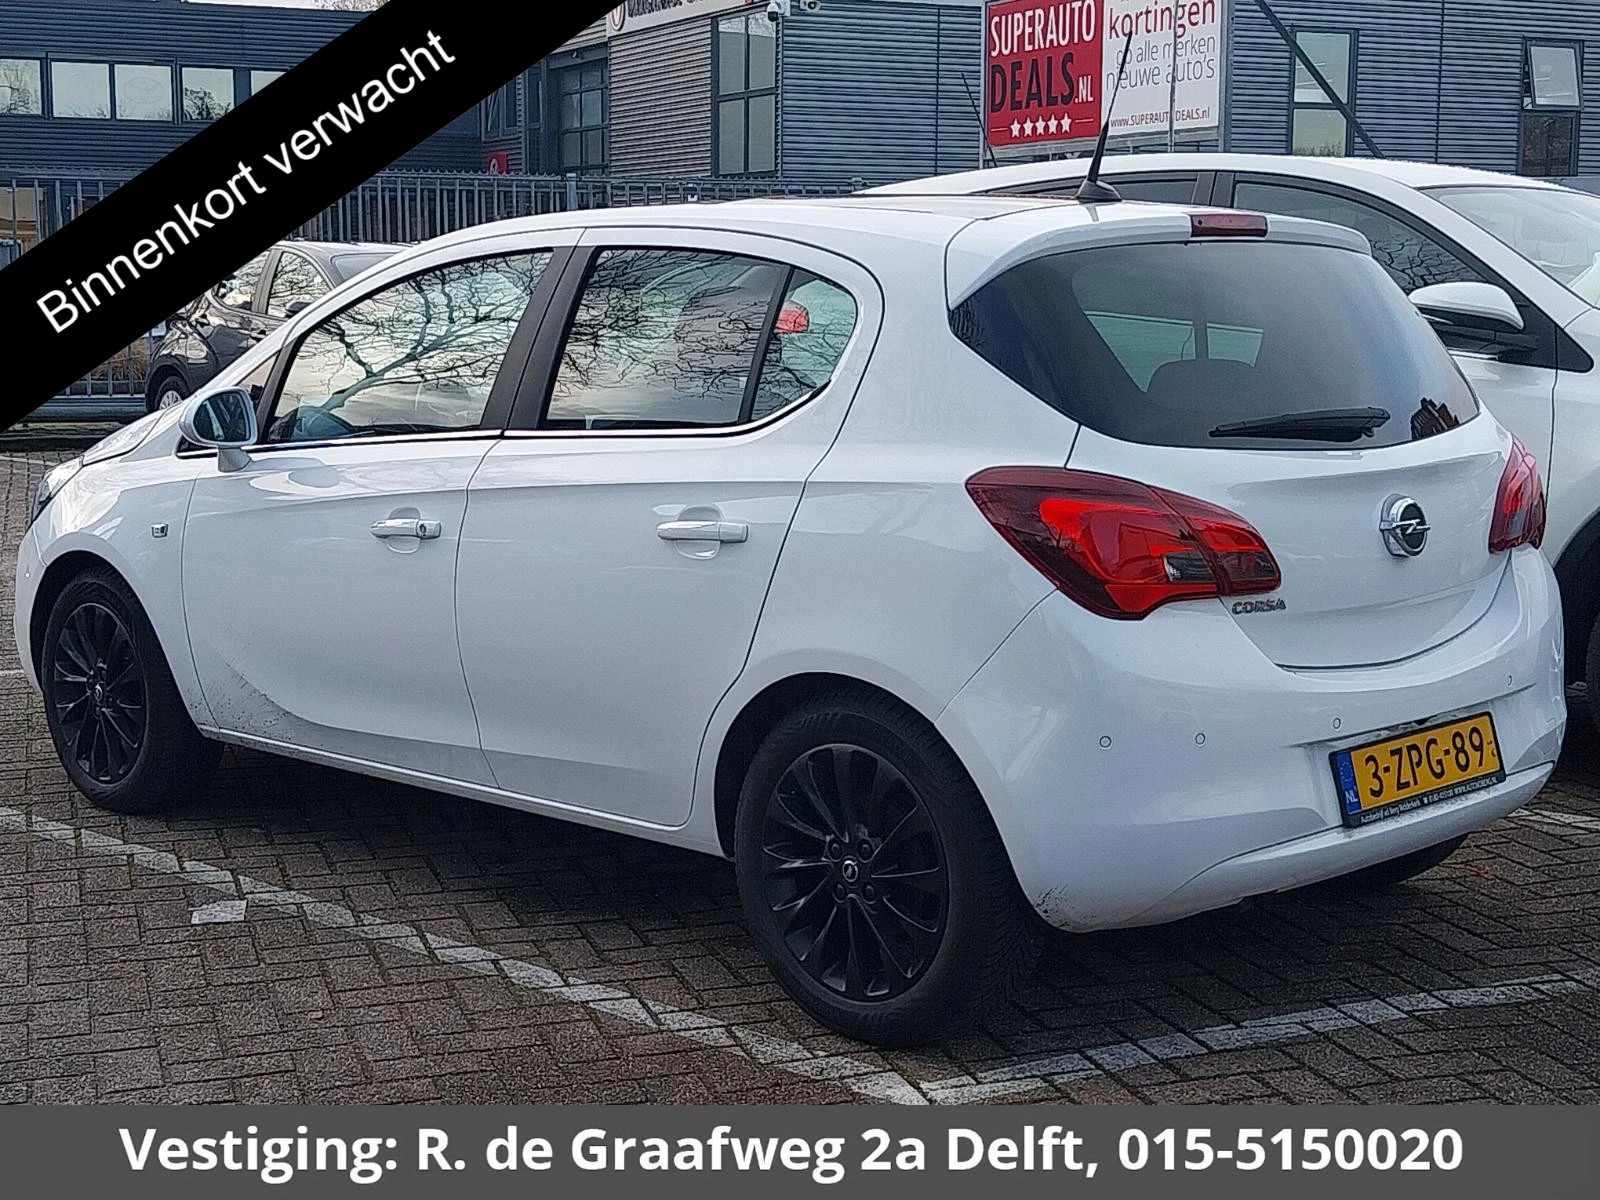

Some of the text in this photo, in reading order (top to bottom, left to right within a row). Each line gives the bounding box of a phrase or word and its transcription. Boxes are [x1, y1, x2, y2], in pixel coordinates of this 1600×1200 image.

[990, 0, 1096, 57] SUPERAUTO
[1109, 0, 1216, 40] kortingen
[1136, 39, 1159, 63] alle
[1162, 33, 1216, 59] merken
[1106, 65, 1161, 91] nieuwe
[1110, 106, 1210, 128] www.SUPERAUTDEALS.nl
[1231, 598, 1287, 615] CORSA
[1364, 726, 1484, 798] 3-ZPG-89
[1344, 789, 1359, 804] NL
